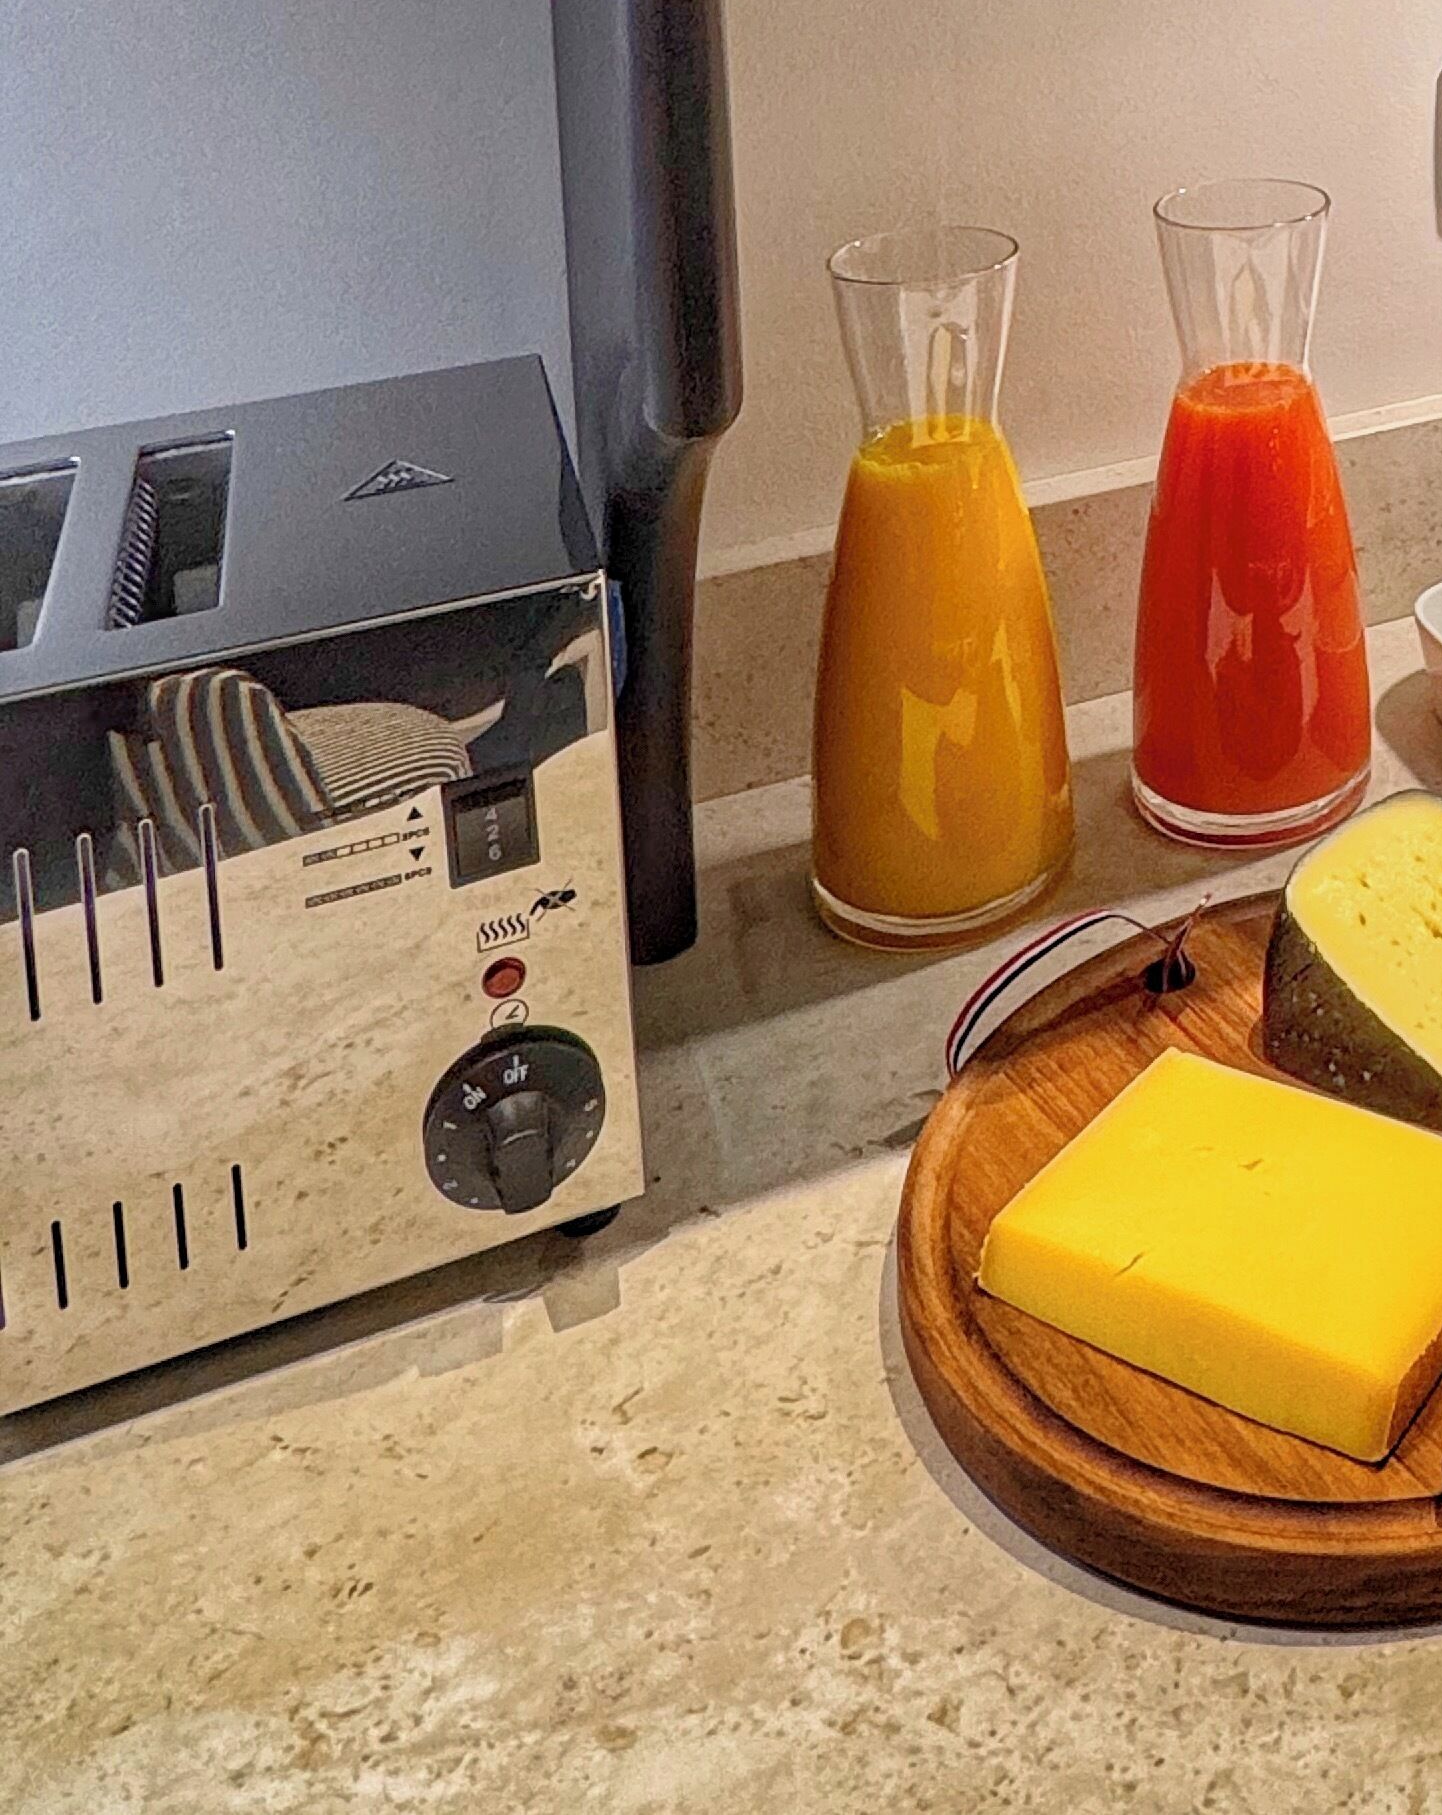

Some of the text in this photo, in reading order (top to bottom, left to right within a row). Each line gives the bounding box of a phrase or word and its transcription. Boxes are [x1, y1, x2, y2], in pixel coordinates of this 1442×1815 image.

[485, 807, 498, 820] 4
[486, 824, 500, 842] 2
[488, 843, 502, 861] 6
[463, 1086, 487, 1110] ON
